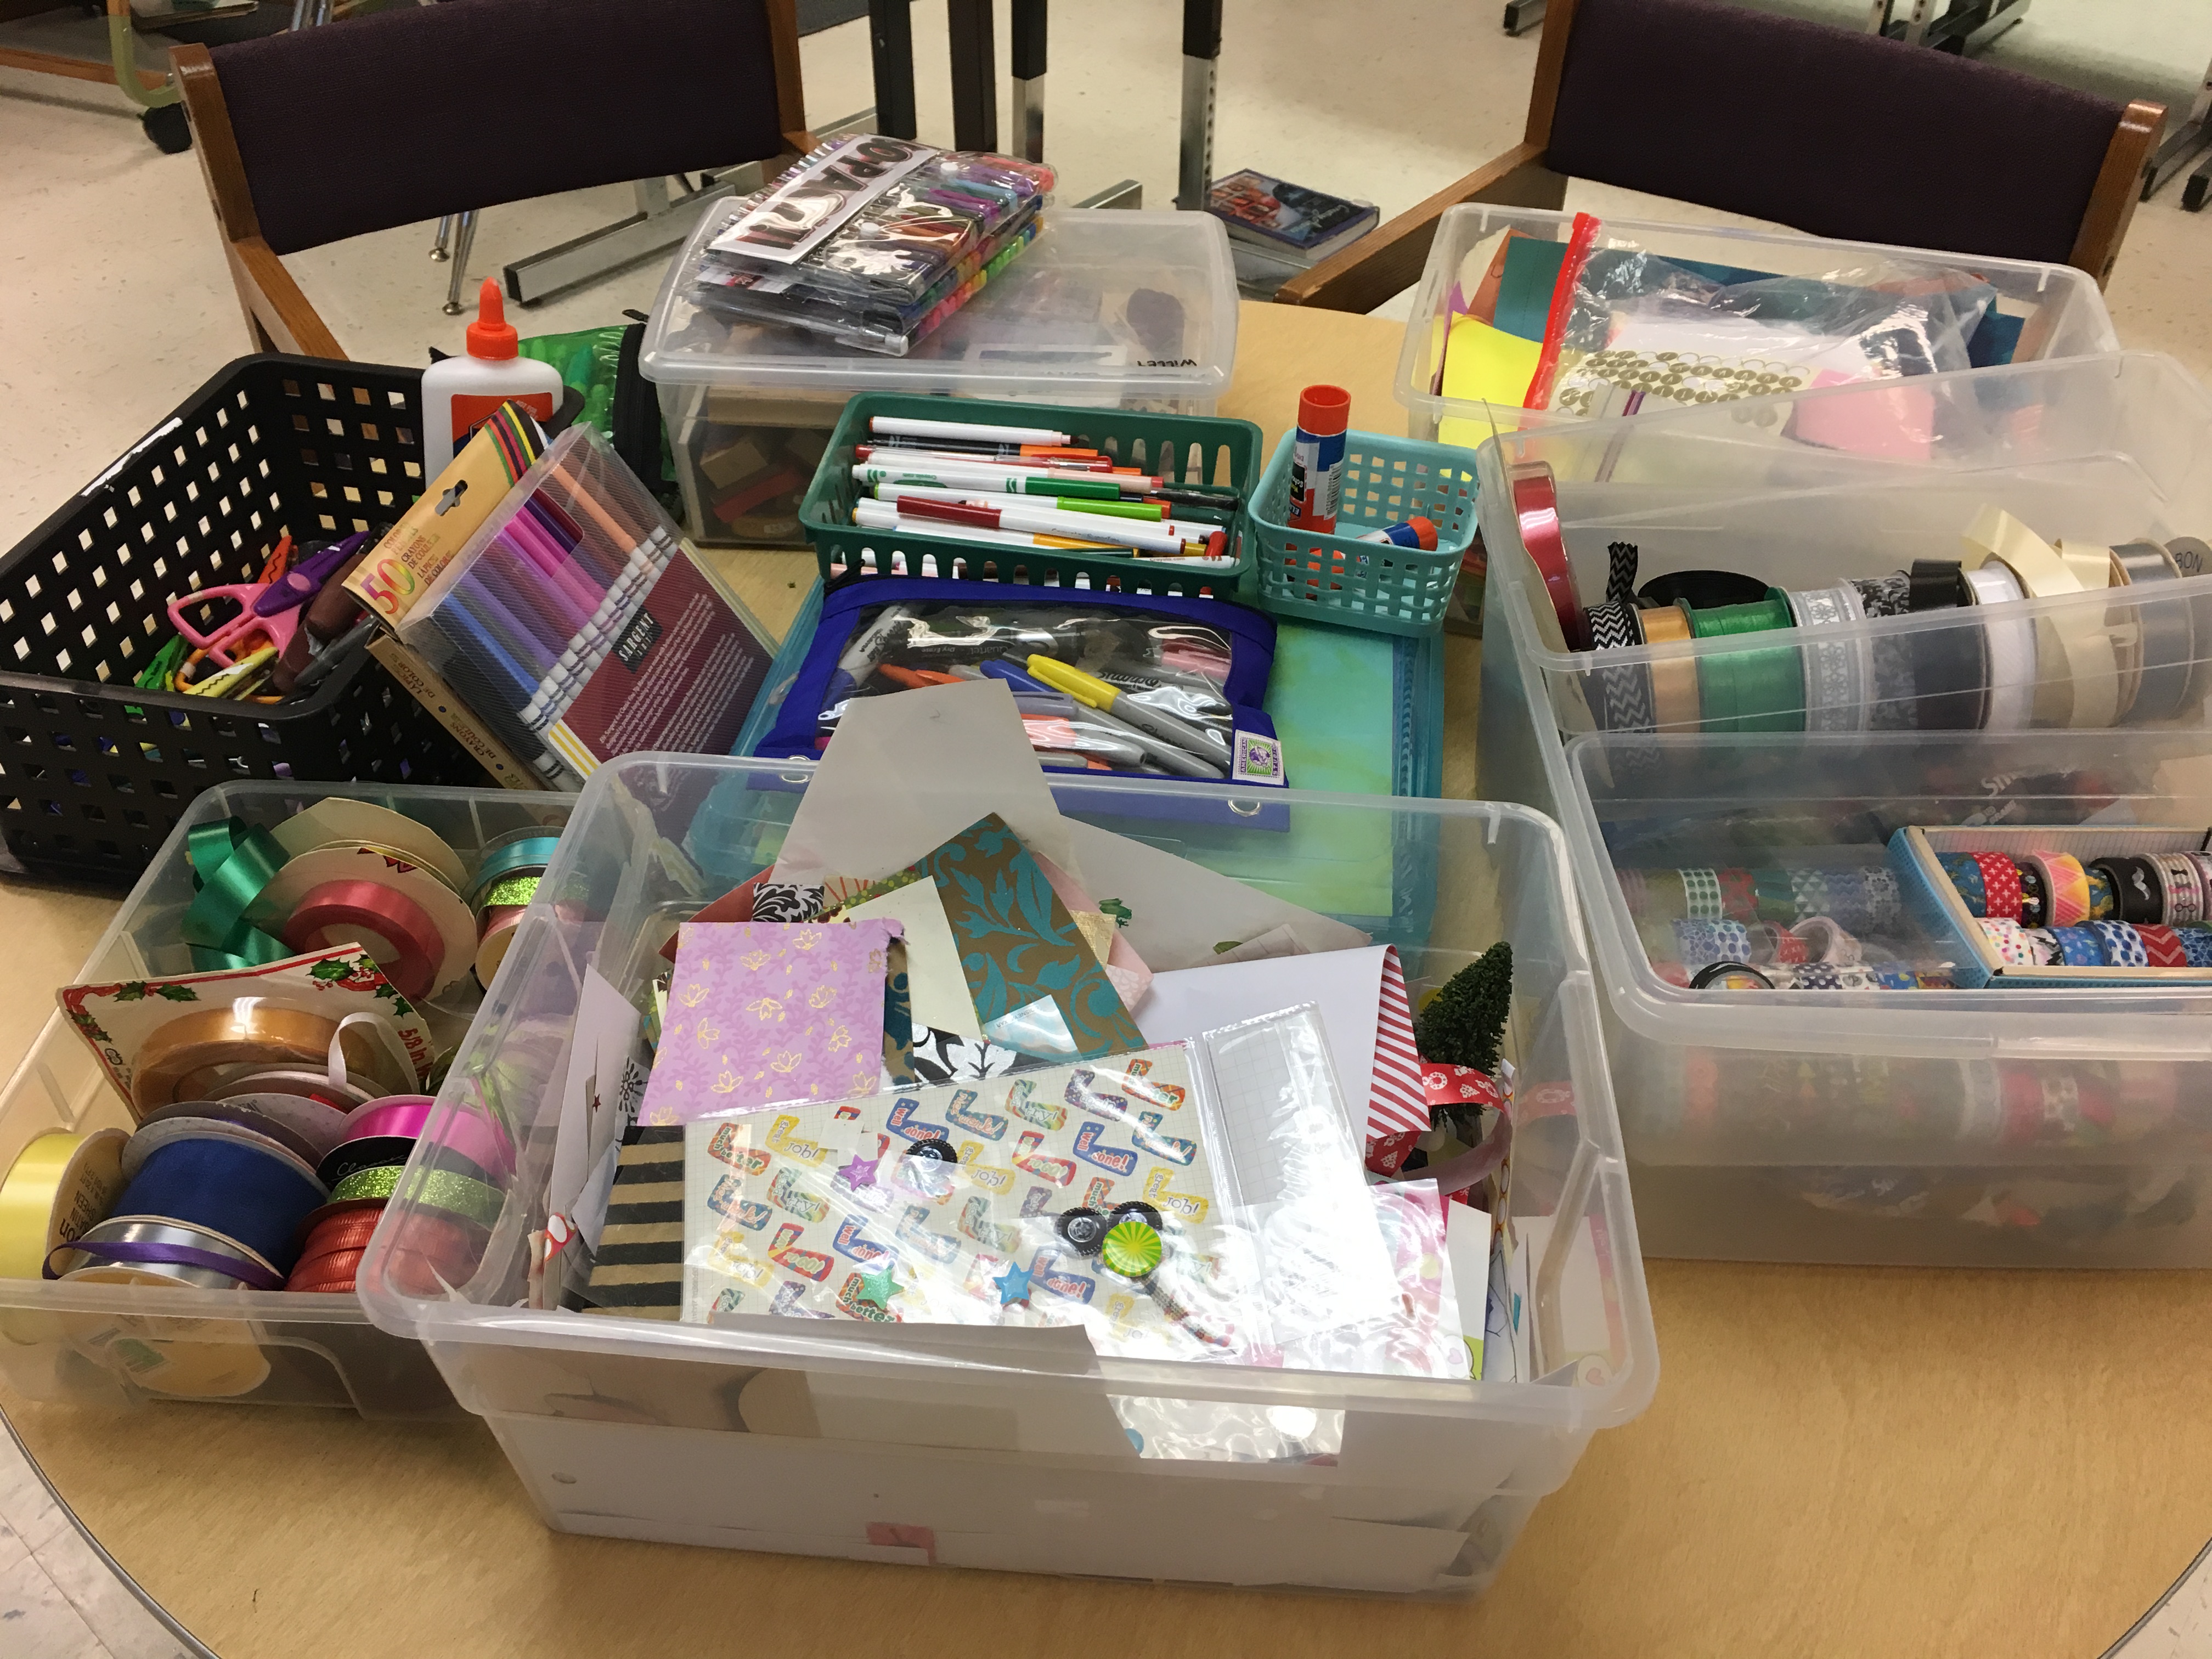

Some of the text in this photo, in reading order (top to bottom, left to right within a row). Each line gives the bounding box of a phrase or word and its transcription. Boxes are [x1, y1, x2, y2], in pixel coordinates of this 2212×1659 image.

[1137, 359, 1197, 368] WILLET
[400, 535, 427, 563] CRAYONS
[360, 558, 415, 614] 50
[619, 613, 653, 661] SARGENT
[637, 637, 651, 656] ART
[969, 645, 1008, 655] Quartet
[450, 722, 485, 756] CRAYONS
[398, 1028, 424, 1049] 5/8
[891, 1108, 907, 1126] well
[958, 1115, 1004, 1135] work!
[1025, 1107, 1059, 1121] try!
[714, 1127, 731, 1150] much
[1077, 1132, 1094, 1151] well
[1088, 1182, 1102, 1207] much
[1149, 1173, 1164, 1198] great
[74, 1190, 96, 1221] SHEEN
[786, 1196, 821, 1212] try!
[70, 1207, 89, 1231] SATIN
[838, 1225, 855, 1245] well
[843, 1278, 861, 1304] much
